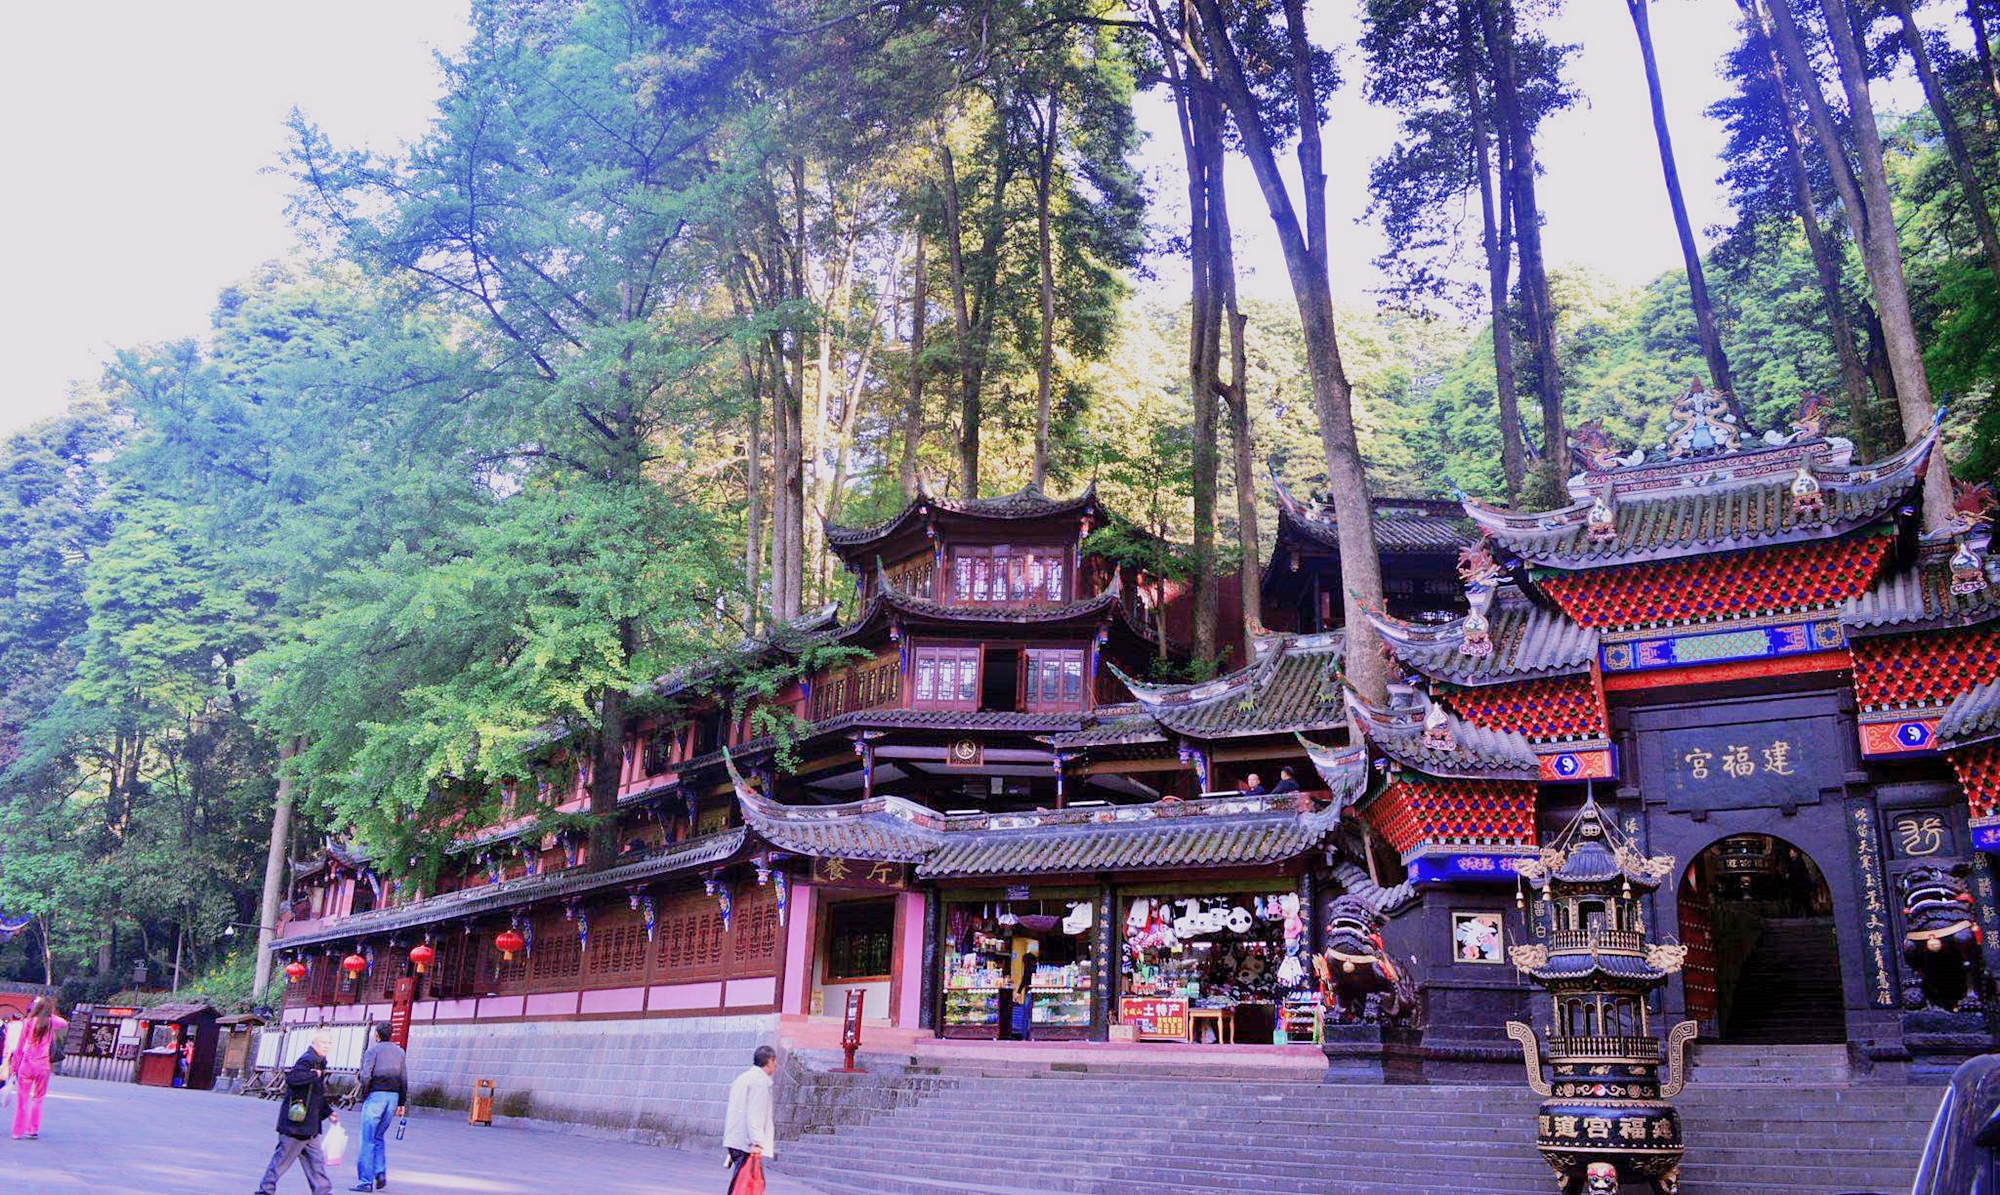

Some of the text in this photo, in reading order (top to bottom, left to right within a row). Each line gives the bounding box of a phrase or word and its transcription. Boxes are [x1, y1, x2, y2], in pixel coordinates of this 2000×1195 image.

[822, 856, 893, 883] 餐厅
[1143, 1003, 1180, 1017] 土特产
